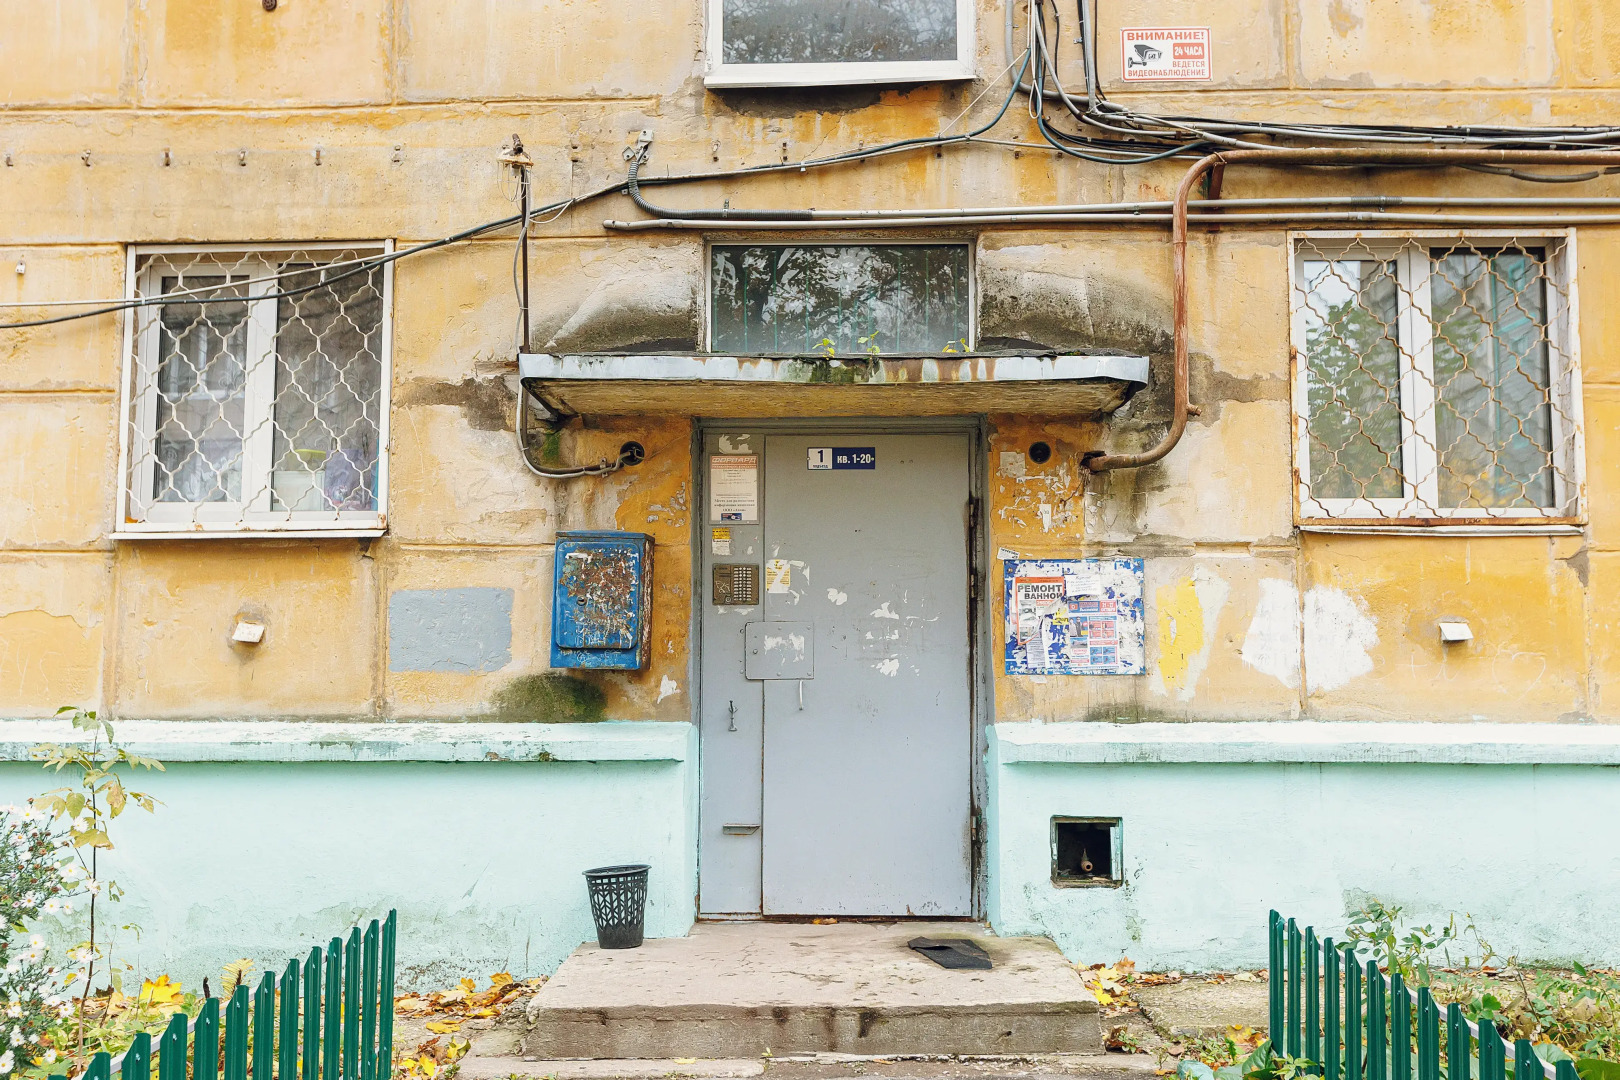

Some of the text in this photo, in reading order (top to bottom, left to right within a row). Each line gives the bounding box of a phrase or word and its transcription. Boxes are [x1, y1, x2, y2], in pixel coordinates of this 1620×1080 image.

[1126, 31, 1205, 41] ВНИМАНИЕ!
[1174, 46, 1203, 56] 24 ЧАСА
[1172, 60, 1206, 69] ВЕДЕТСЯ
[1127, 68, 1206, 78] ВИДЕОНАБЛЮДЕНИЕ
[817, 449, 824, 463] 1
[852, 453, 872, 464] 1-20
[1017, 584, 1063, 593] РЕМОНТ
